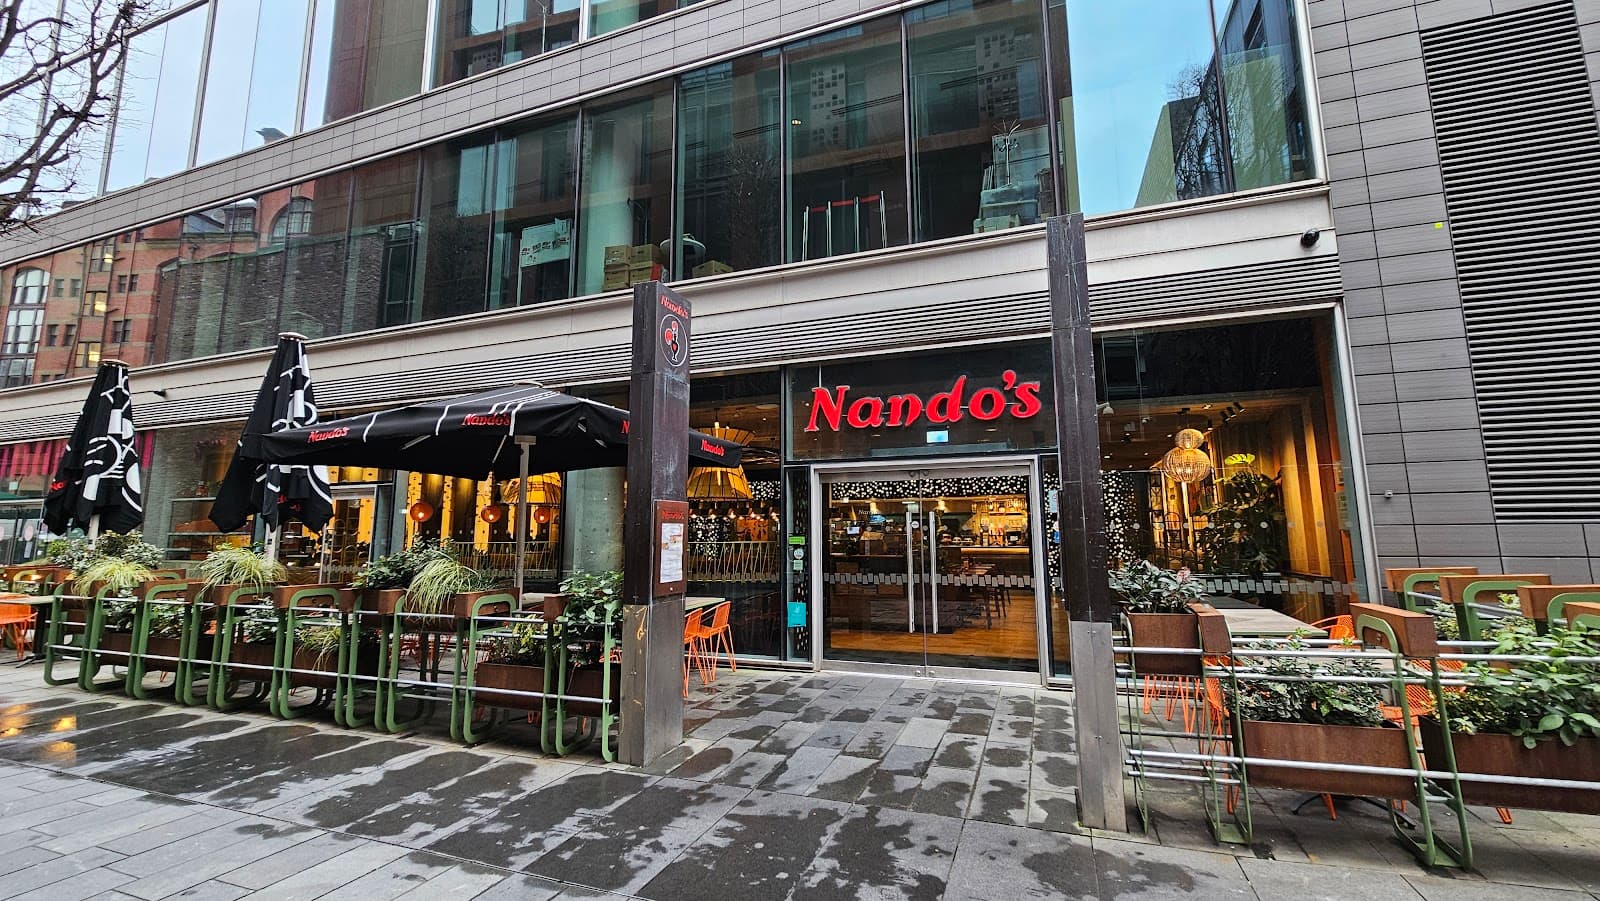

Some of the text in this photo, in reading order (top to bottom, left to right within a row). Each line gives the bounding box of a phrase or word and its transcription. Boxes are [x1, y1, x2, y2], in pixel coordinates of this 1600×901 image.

[661, 294, 688, 319] Nando's
[804, 370, 1041, 432] Nando's
[462, 411, 511, 426] Nando's
[307, 426, 350, 443] Nando's
[701, 439, 725, 456] Nando's
